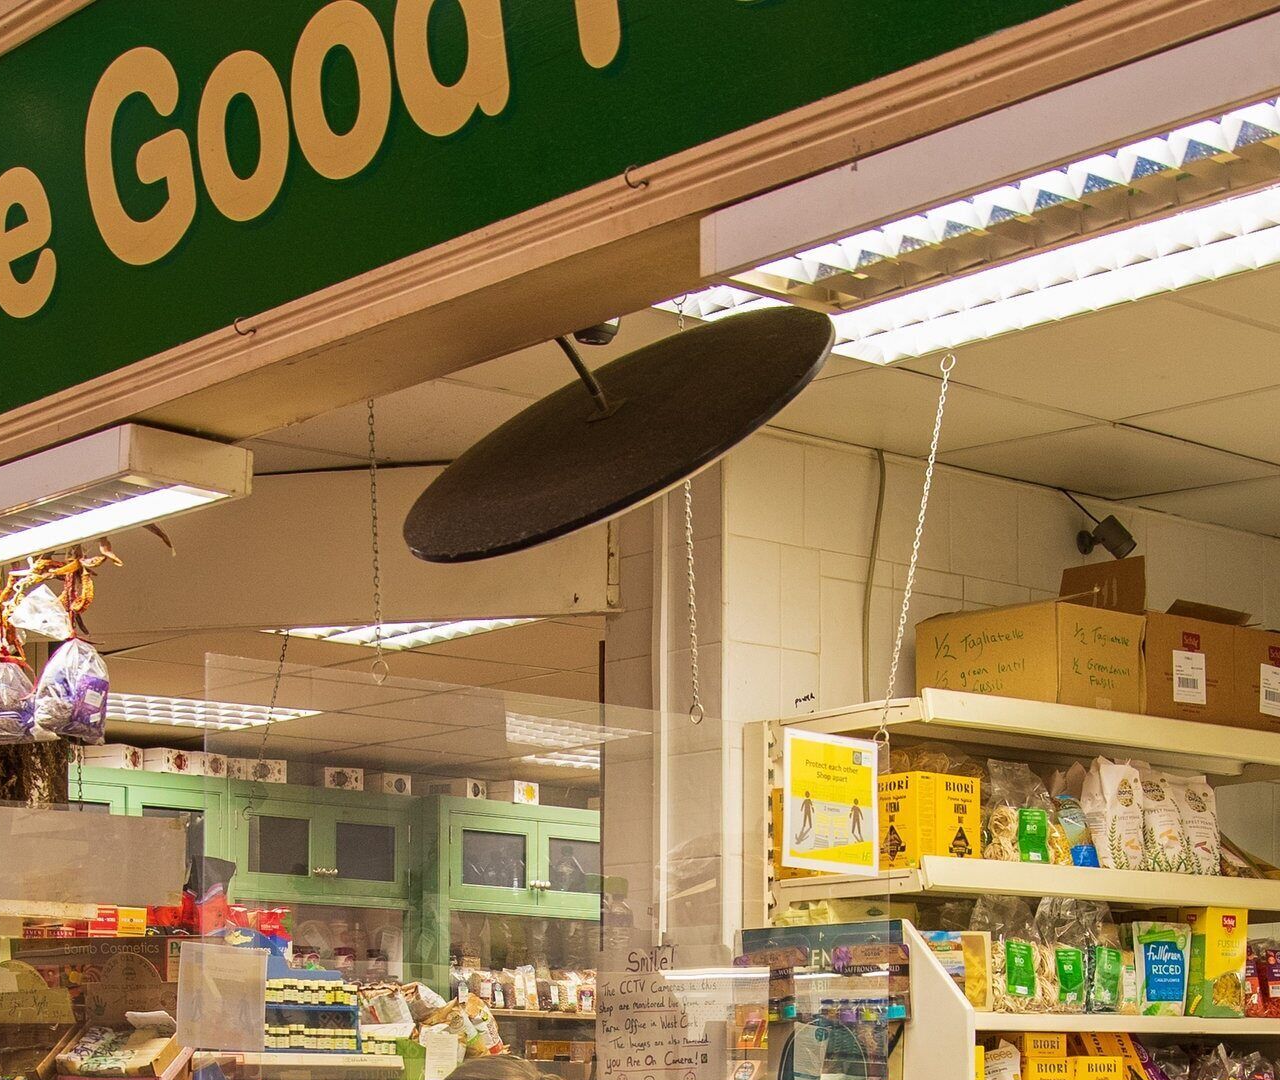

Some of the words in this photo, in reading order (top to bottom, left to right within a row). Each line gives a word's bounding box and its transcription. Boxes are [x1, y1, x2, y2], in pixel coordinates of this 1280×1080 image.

[85, 0, 508, 265] Good
[828, 764, 840, 772] each
[842, 765, 859, 774] other
[816, 770, 832, 782] Shop
[832, 774, 848, 785] apart
[100, 942, 160, 955] Cosmetics
[626, 949, 676, 973] Smile!
[1151, 964, 1182, 977] RICED
[602, 982, 616, 998] The
[619, 978, 646, 995] CCTV
[632, 998, 665, 1009] monitored
[624, 1017, 647, 1035] Office
[660, 1015, 678, 1031] West
[626, 1055, 641, 1068] Are
[644, 1054, 657, 1067] On
[663, 1050, 699, 1067] Camera!
